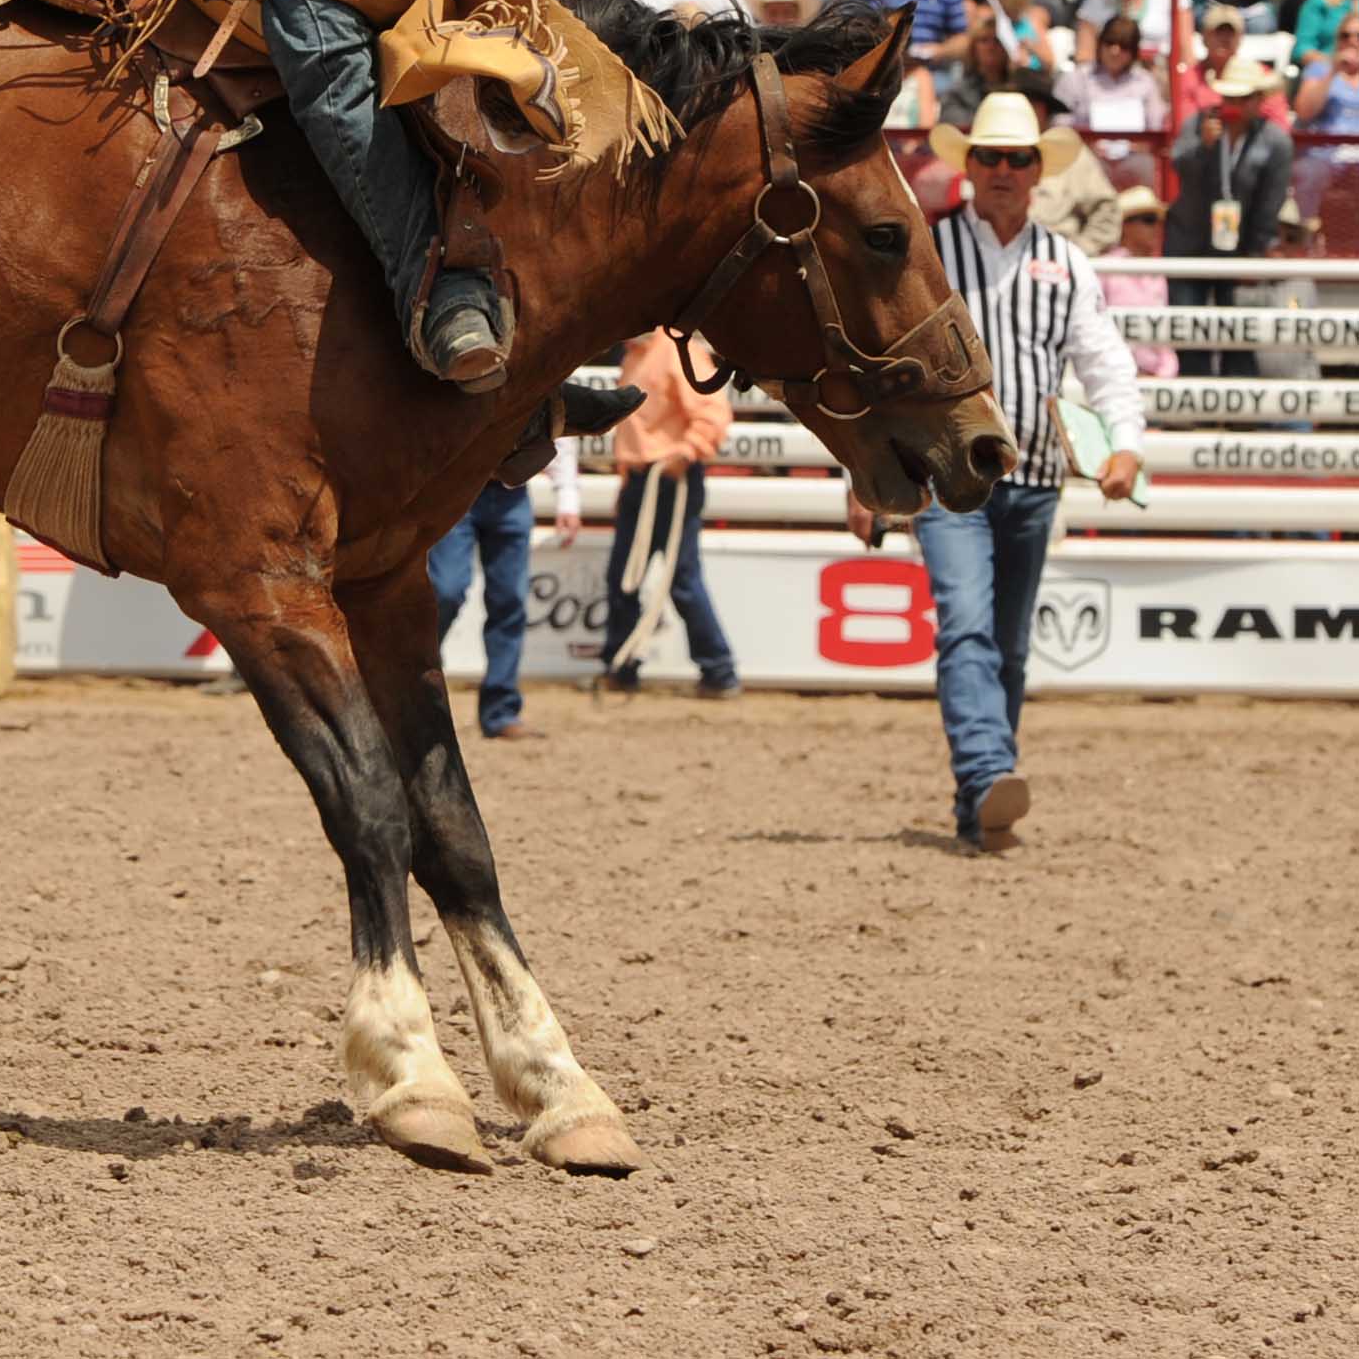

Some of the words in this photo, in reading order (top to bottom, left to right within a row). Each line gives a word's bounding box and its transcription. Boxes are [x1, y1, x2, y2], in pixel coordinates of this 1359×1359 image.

[1113, 315, 1259, 341] EYENNE
[1280, 390, 1321, 414] OF
[819, 558, 938, 668] 8
[1139, 607, 1359, 639] RAM
